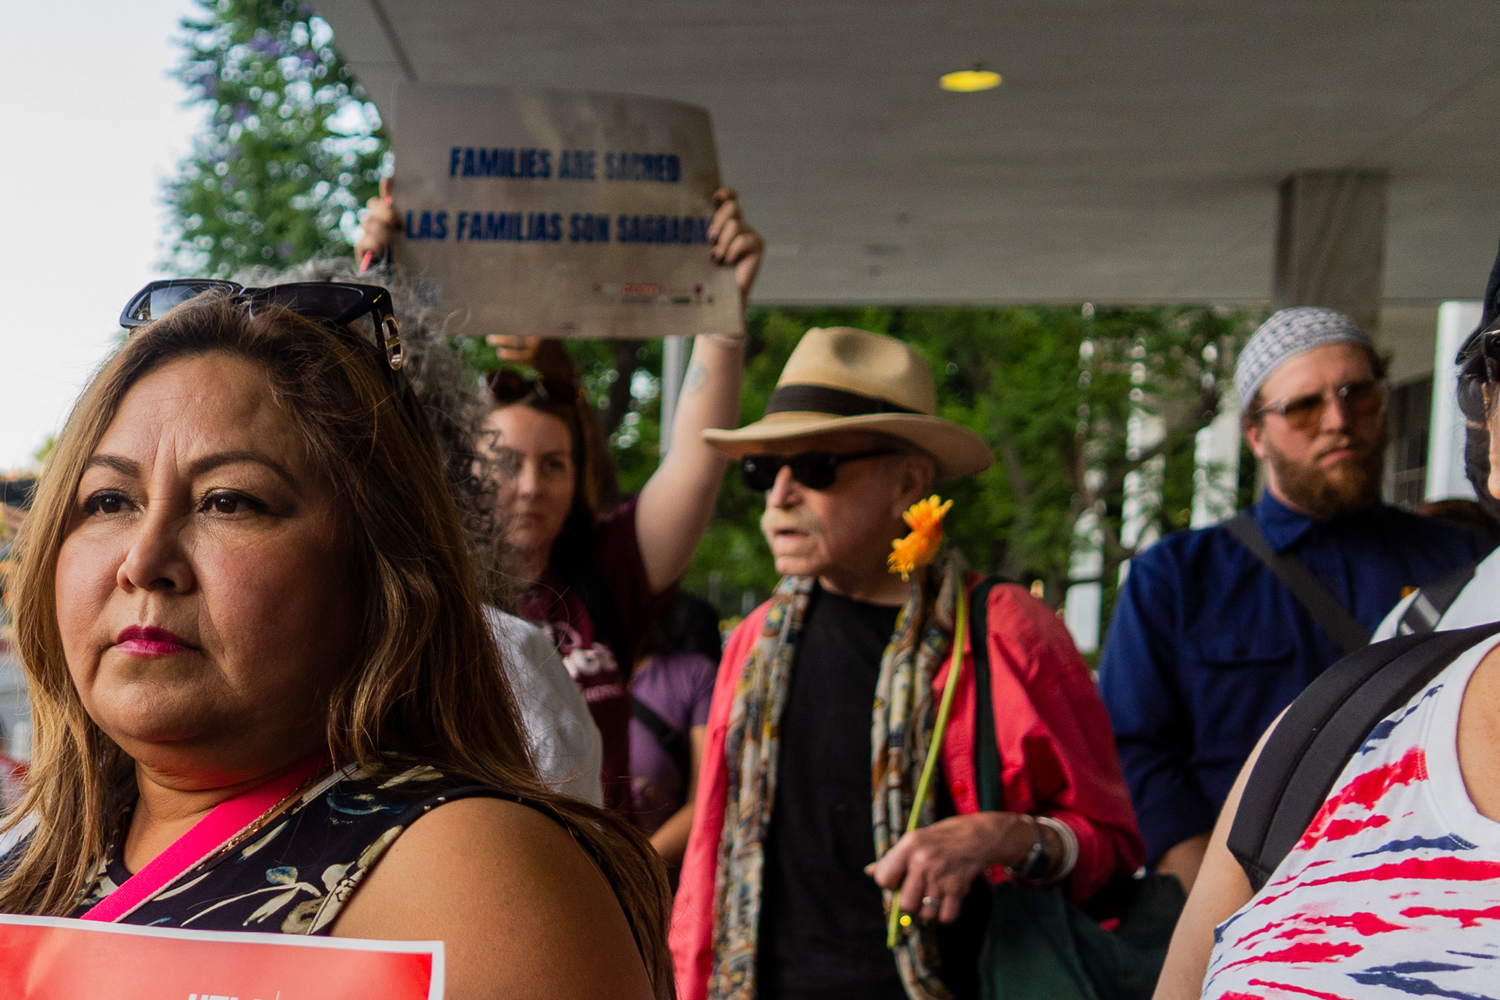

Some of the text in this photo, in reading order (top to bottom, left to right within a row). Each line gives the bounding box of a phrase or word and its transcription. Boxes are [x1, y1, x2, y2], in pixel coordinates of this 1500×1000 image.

[450, 147, 682, 183] FAMILIES ARE SACRED
[406, 211, 448, 240] LAS
[457, 212, 562, 242] FAMILIAS
[569, 214, 611, 242] SON
